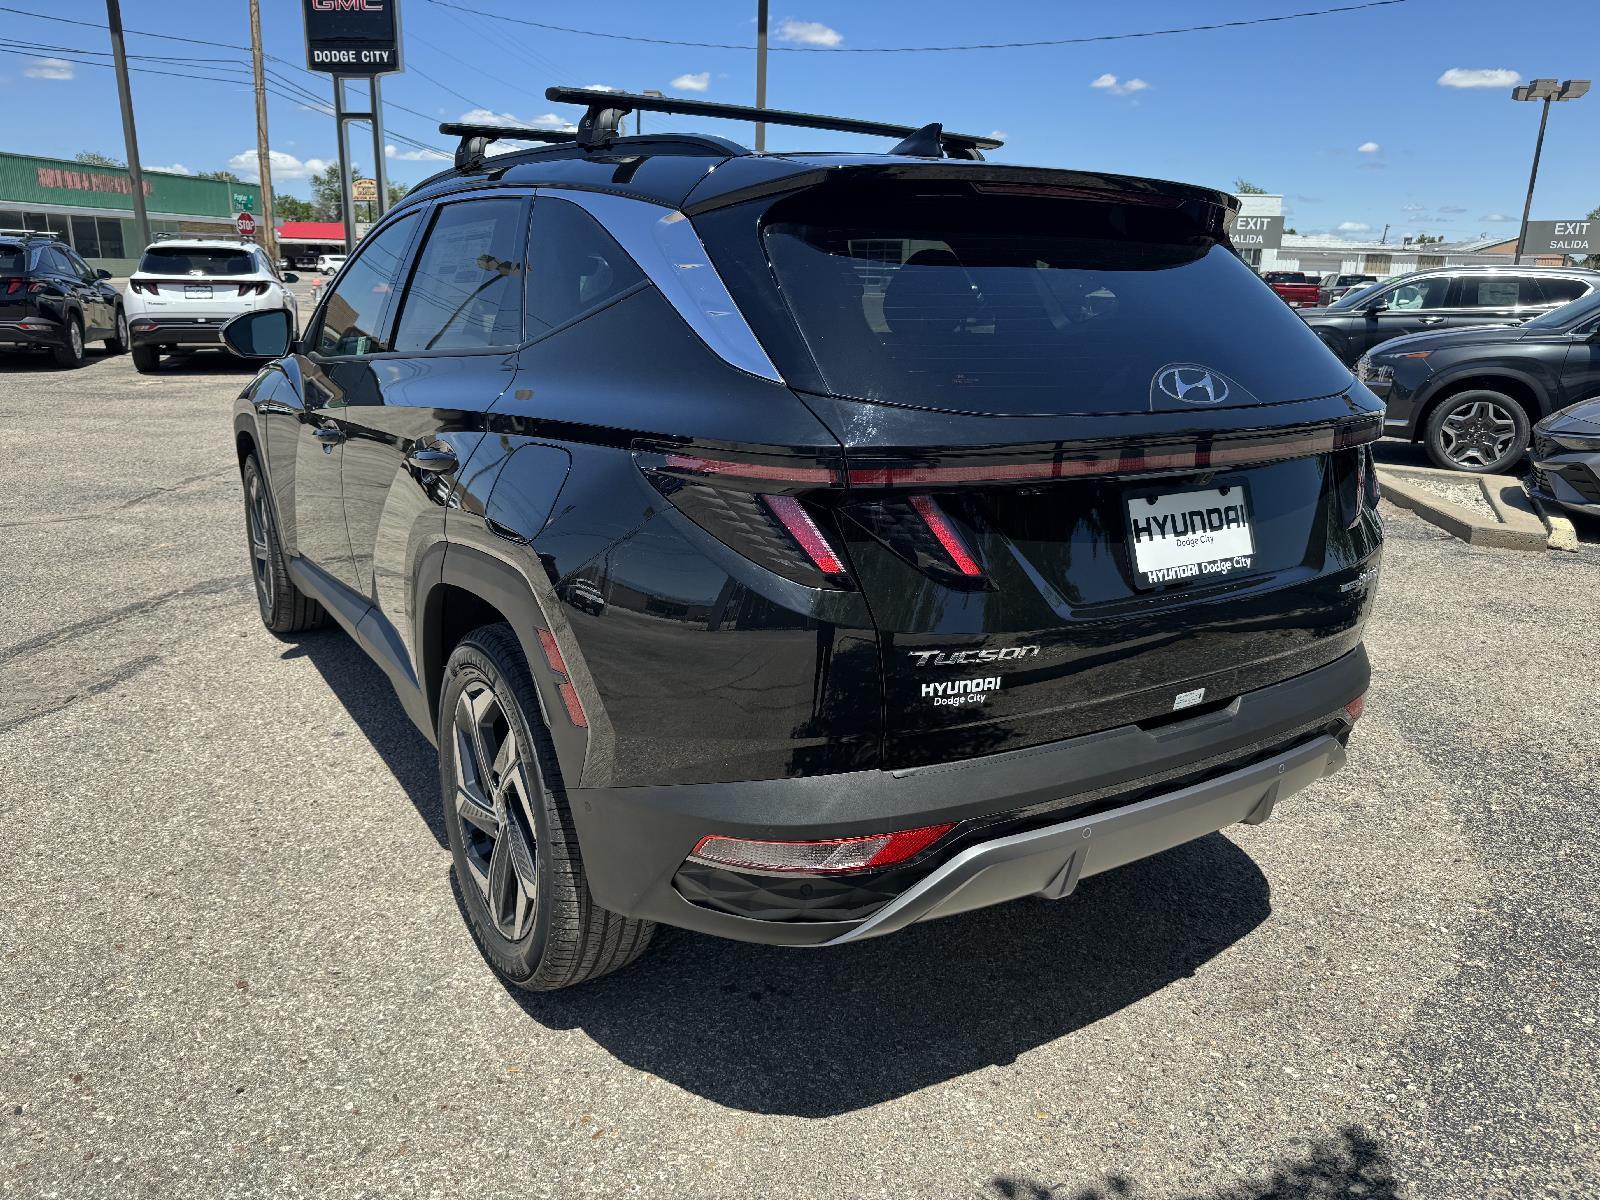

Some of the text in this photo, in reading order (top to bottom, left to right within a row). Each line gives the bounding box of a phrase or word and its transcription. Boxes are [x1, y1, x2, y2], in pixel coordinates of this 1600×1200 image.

[314, 50, 389, 63] DODGE CITY
[238, 219, 255, 231] STOP
[1236, 217, 1271, 231] EXIT
[1554, 222, 1591, 235] EXIT
[1549, 239, 1589, 249] SALIDA
[1132, 504, 1247, 544] HYUNDAI
[1176, 534, 1214, 548] Dodge City
[1147, 556, 1252, 584] HYUNDAI Dodge City
[921, 676, 1002, 697] HYUNDAI
[934, 693, 987, 707] Dodge City
